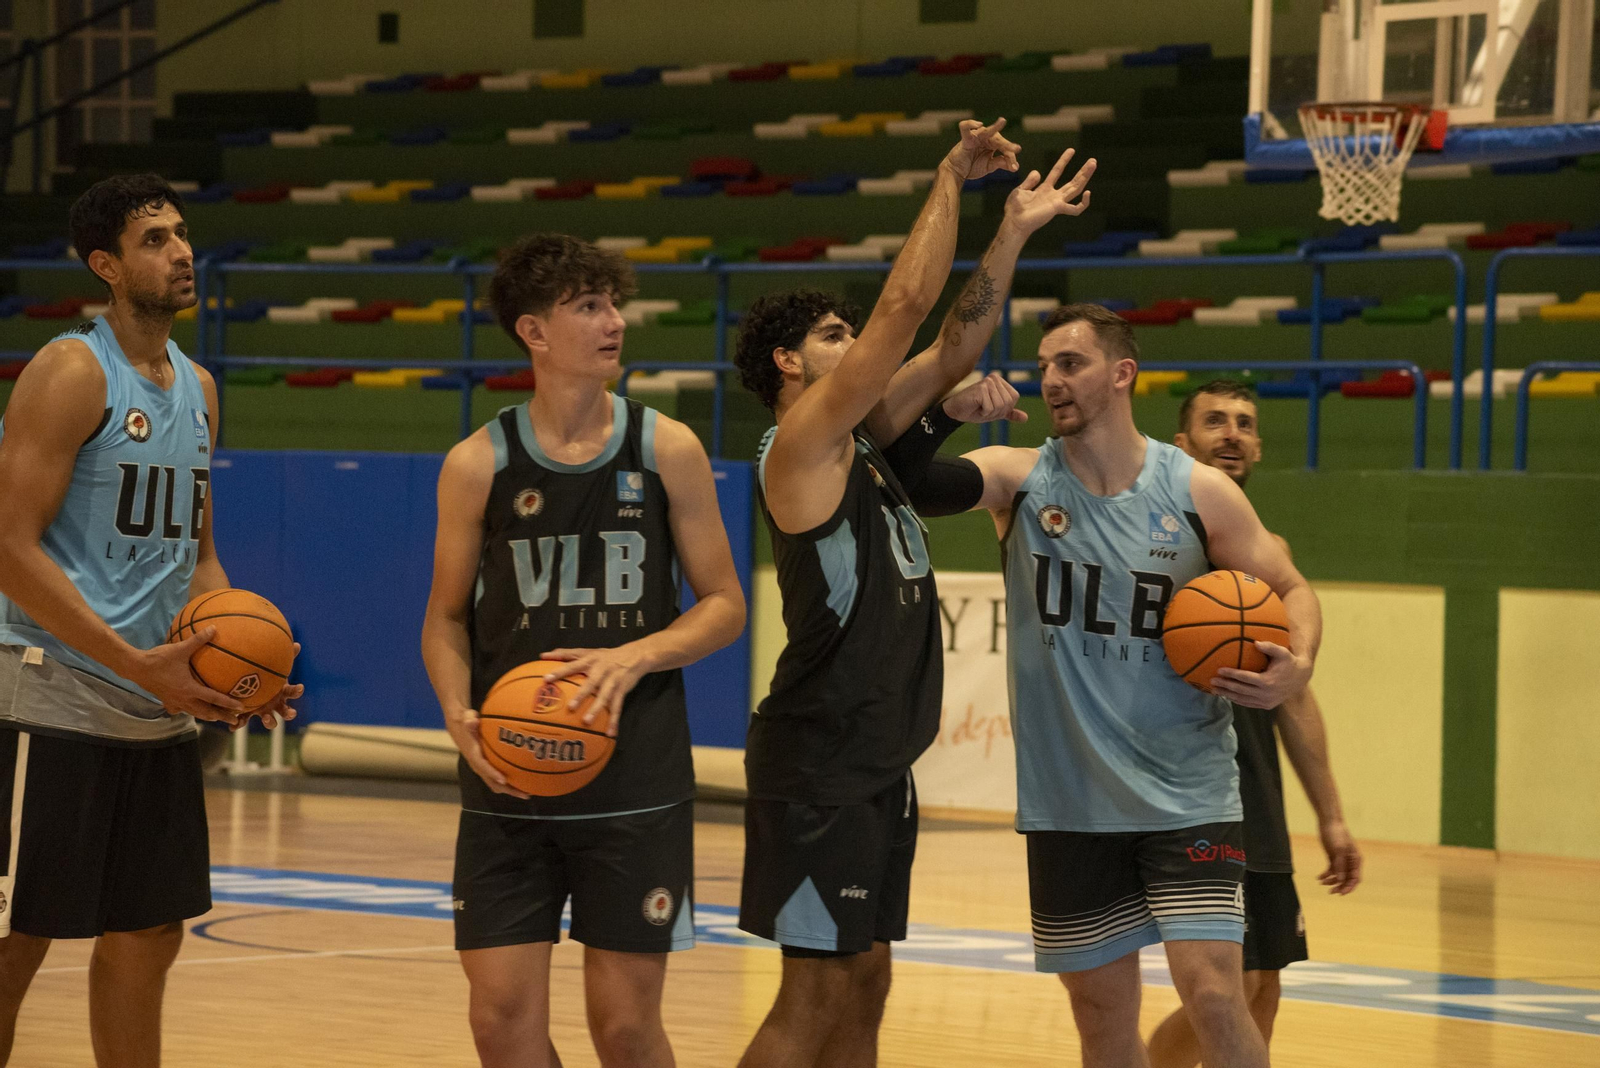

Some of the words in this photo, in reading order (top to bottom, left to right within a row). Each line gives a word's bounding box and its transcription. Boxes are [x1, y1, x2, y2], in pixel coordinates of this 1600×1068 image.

[619, 490, 639, 500] EBA
[1151, 531, 1174, 543] EBA
[106, 541, 136, 562] LA
[900, 584, 921, 605] LA
[1031, 552, 1174, 641] ULB
[559, 607, 645, 629] LÍNEA
[1041, 628, 1057, 651] LA
[1082, 639, 1168, 663] LÍNE
